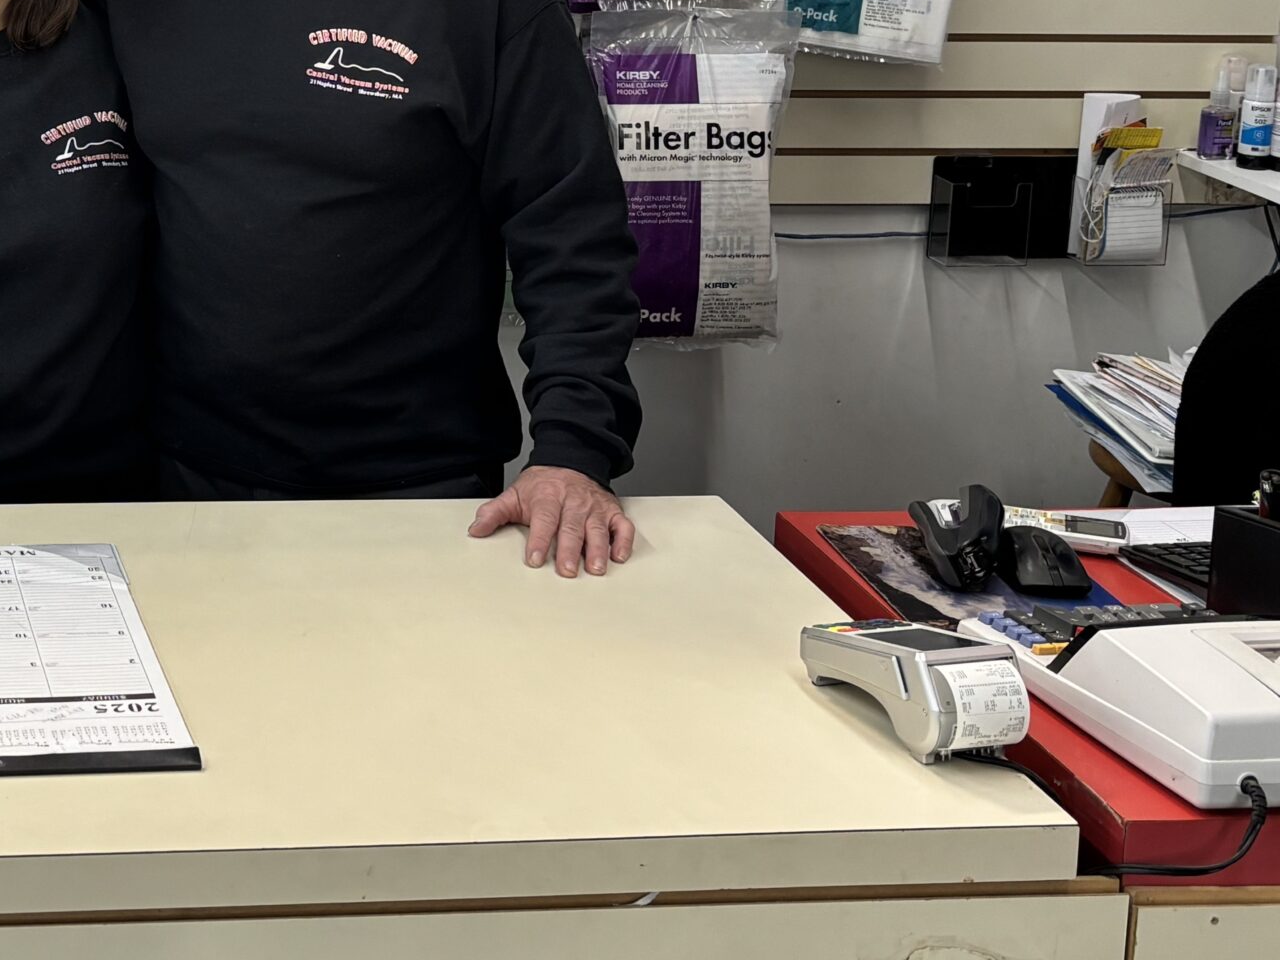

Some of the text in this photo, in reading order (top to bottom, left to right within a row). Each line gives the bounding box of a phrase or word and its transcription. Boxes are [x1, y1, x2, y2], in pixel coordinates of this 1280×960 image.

[308, 28, 418, 65] CERTIFIED VACUUM
[306, 69, 338, 81] Central
[341, 75, 372, 88] Vacuum
[616, 70, 660, 80] KIRBY
[618, 120, 696, 151] Filter
[93, 702, 160, 714] 2025
